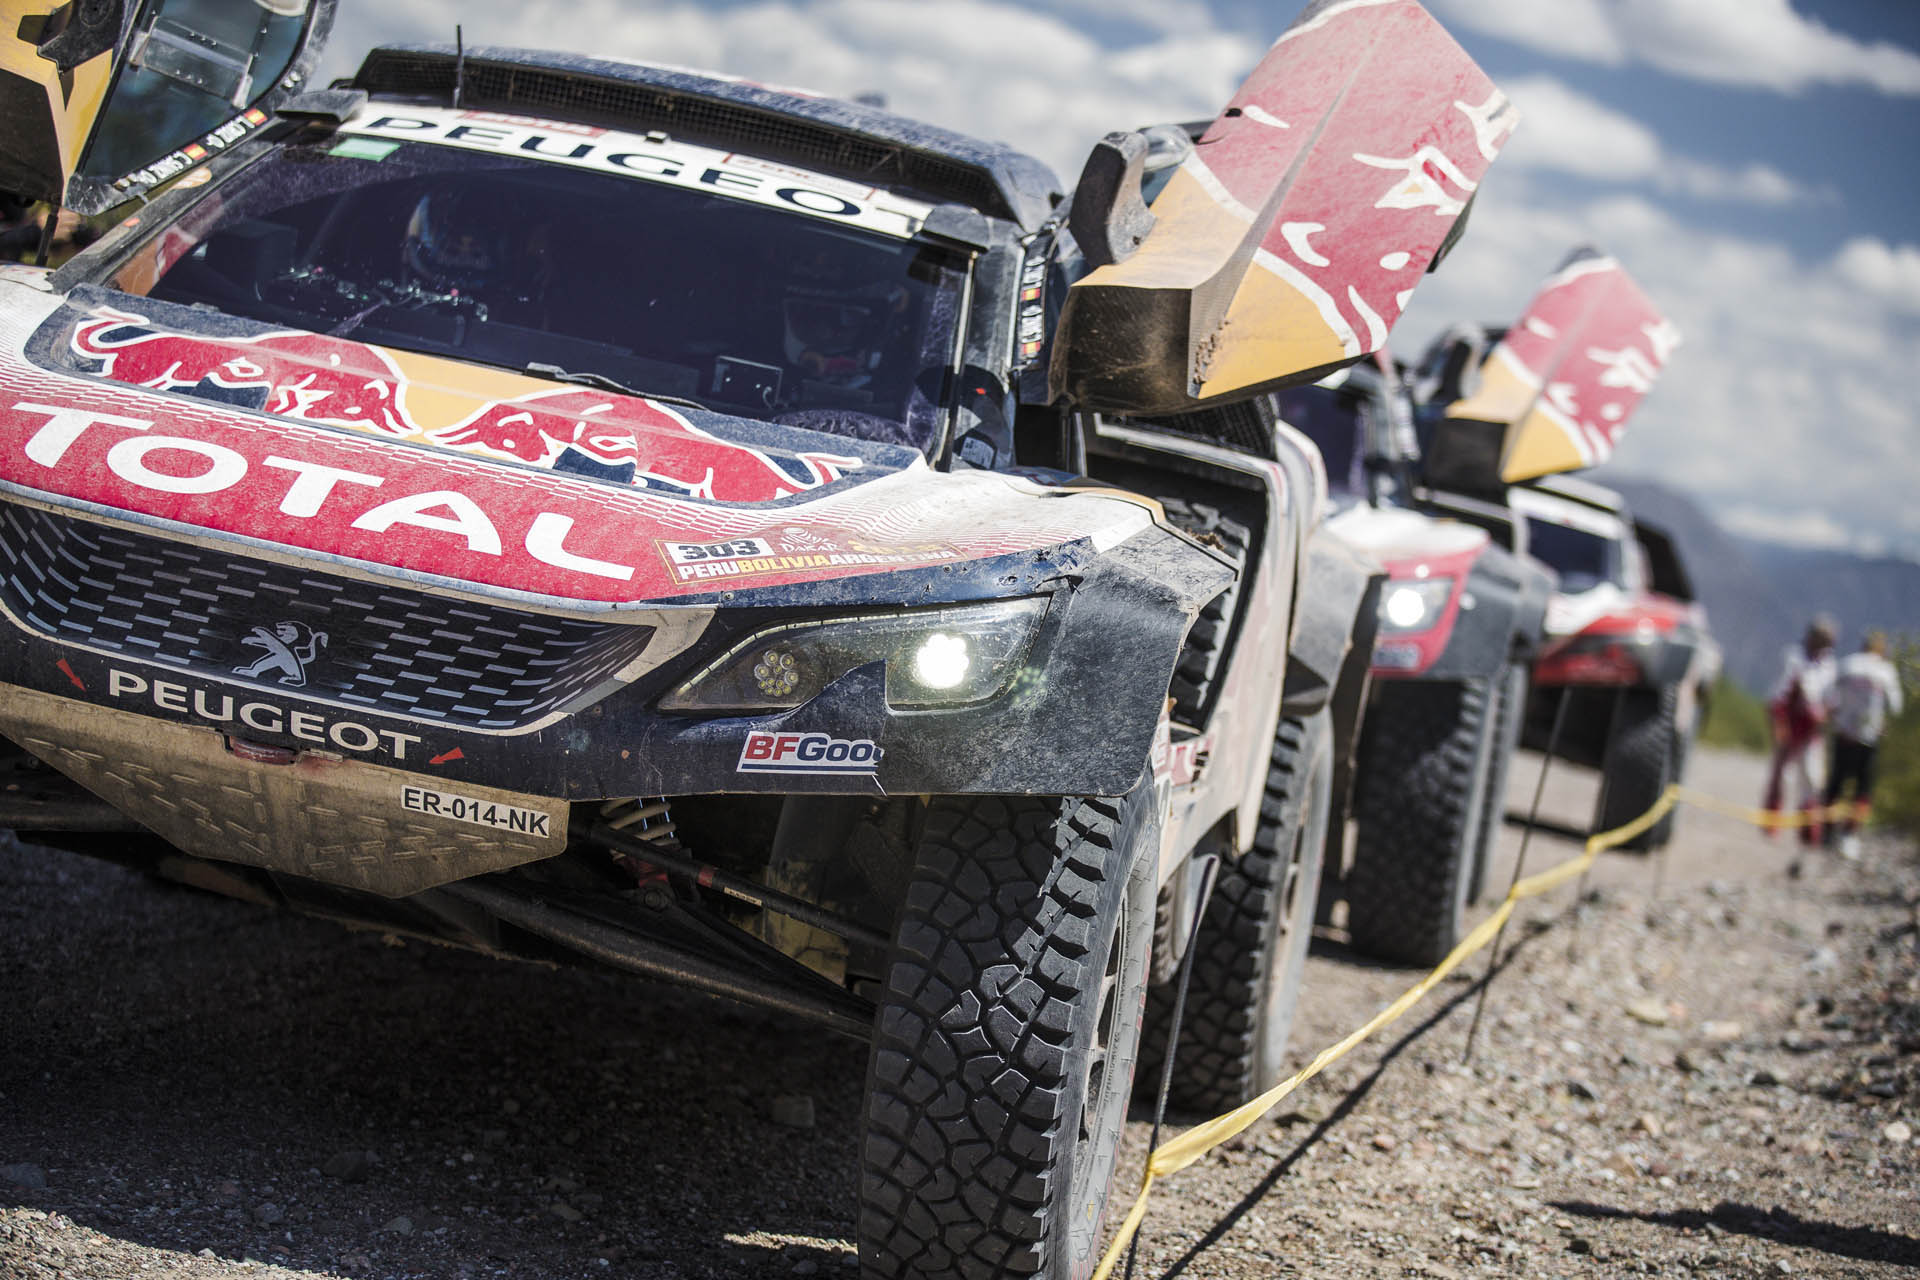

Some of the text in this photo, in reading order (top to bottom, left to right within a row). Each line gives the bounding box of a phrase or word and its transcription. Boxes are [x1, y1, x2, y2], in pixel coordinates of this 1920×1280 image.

[11, 402, 636, 581] TOTAL
[678, 540, 761, 560] 303
[780, 542, 839, 553] DAKAR
[109, 669, 422, 760] PEUGEOT
[404, 788, 549, 836] ER-014-NK
